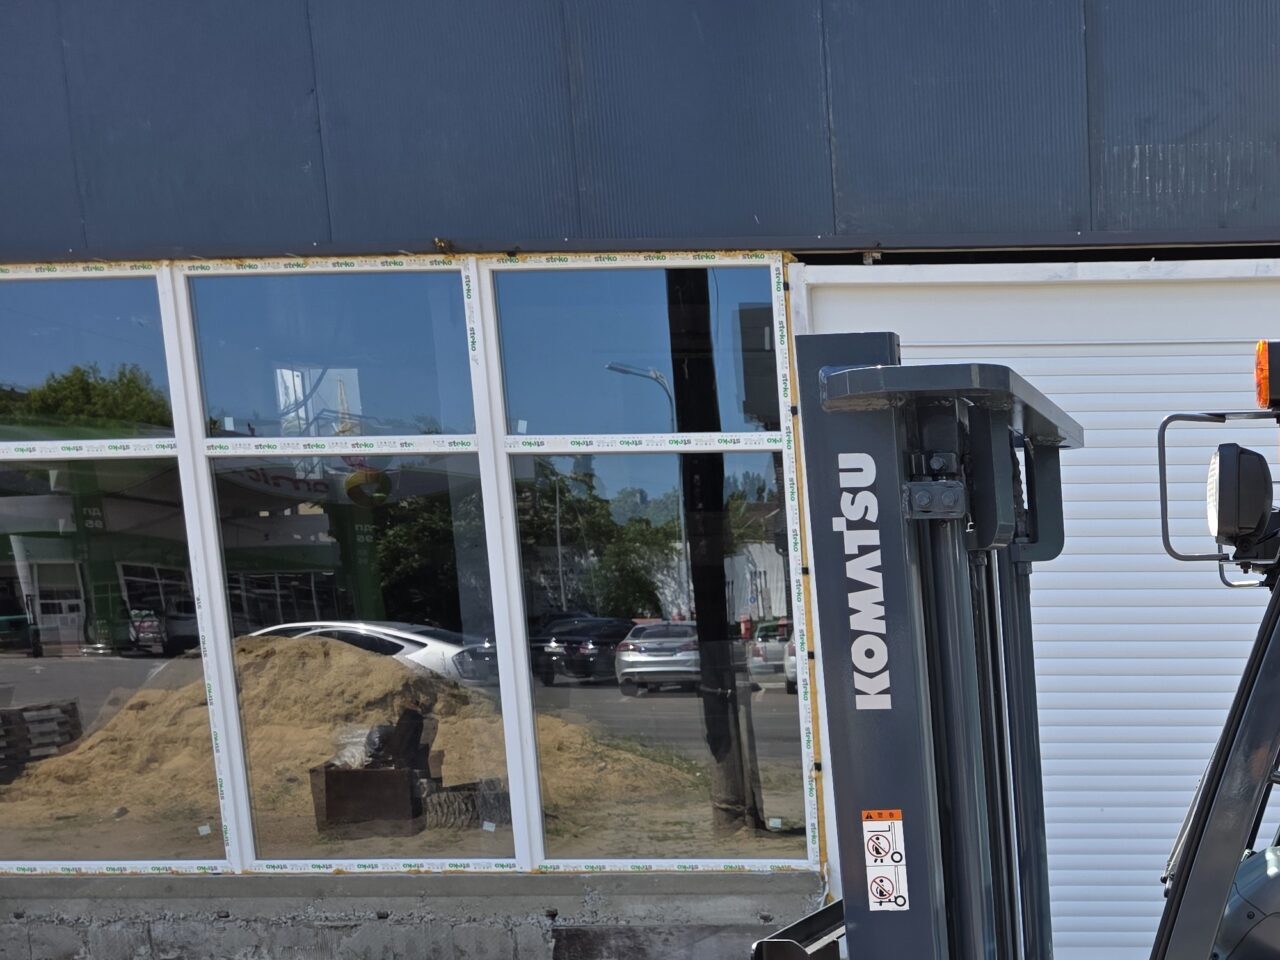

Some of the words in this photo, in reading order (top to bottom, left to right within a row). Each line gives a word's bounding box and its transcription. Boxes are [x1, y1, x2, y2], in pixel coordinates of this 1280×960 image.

[742, 252, 765, 260] steko
[35, 265, 57, 273] steko
[130, 263, 152, 271] steko
[236, 262, 258, 270] steko
[781, 373, 789, 398] steko
[206, 443, 229, 451] steko
[302, 442, 326, 450] steko
[351, 441, 374, 449] steko
[570, 439, 594, 447] steko
[788, 477, 796, 502] steko
[791, 528, 799, 552] steko
[832, 453, 892, 710] KOMATSU
[804, 726, 812, 750] steko
